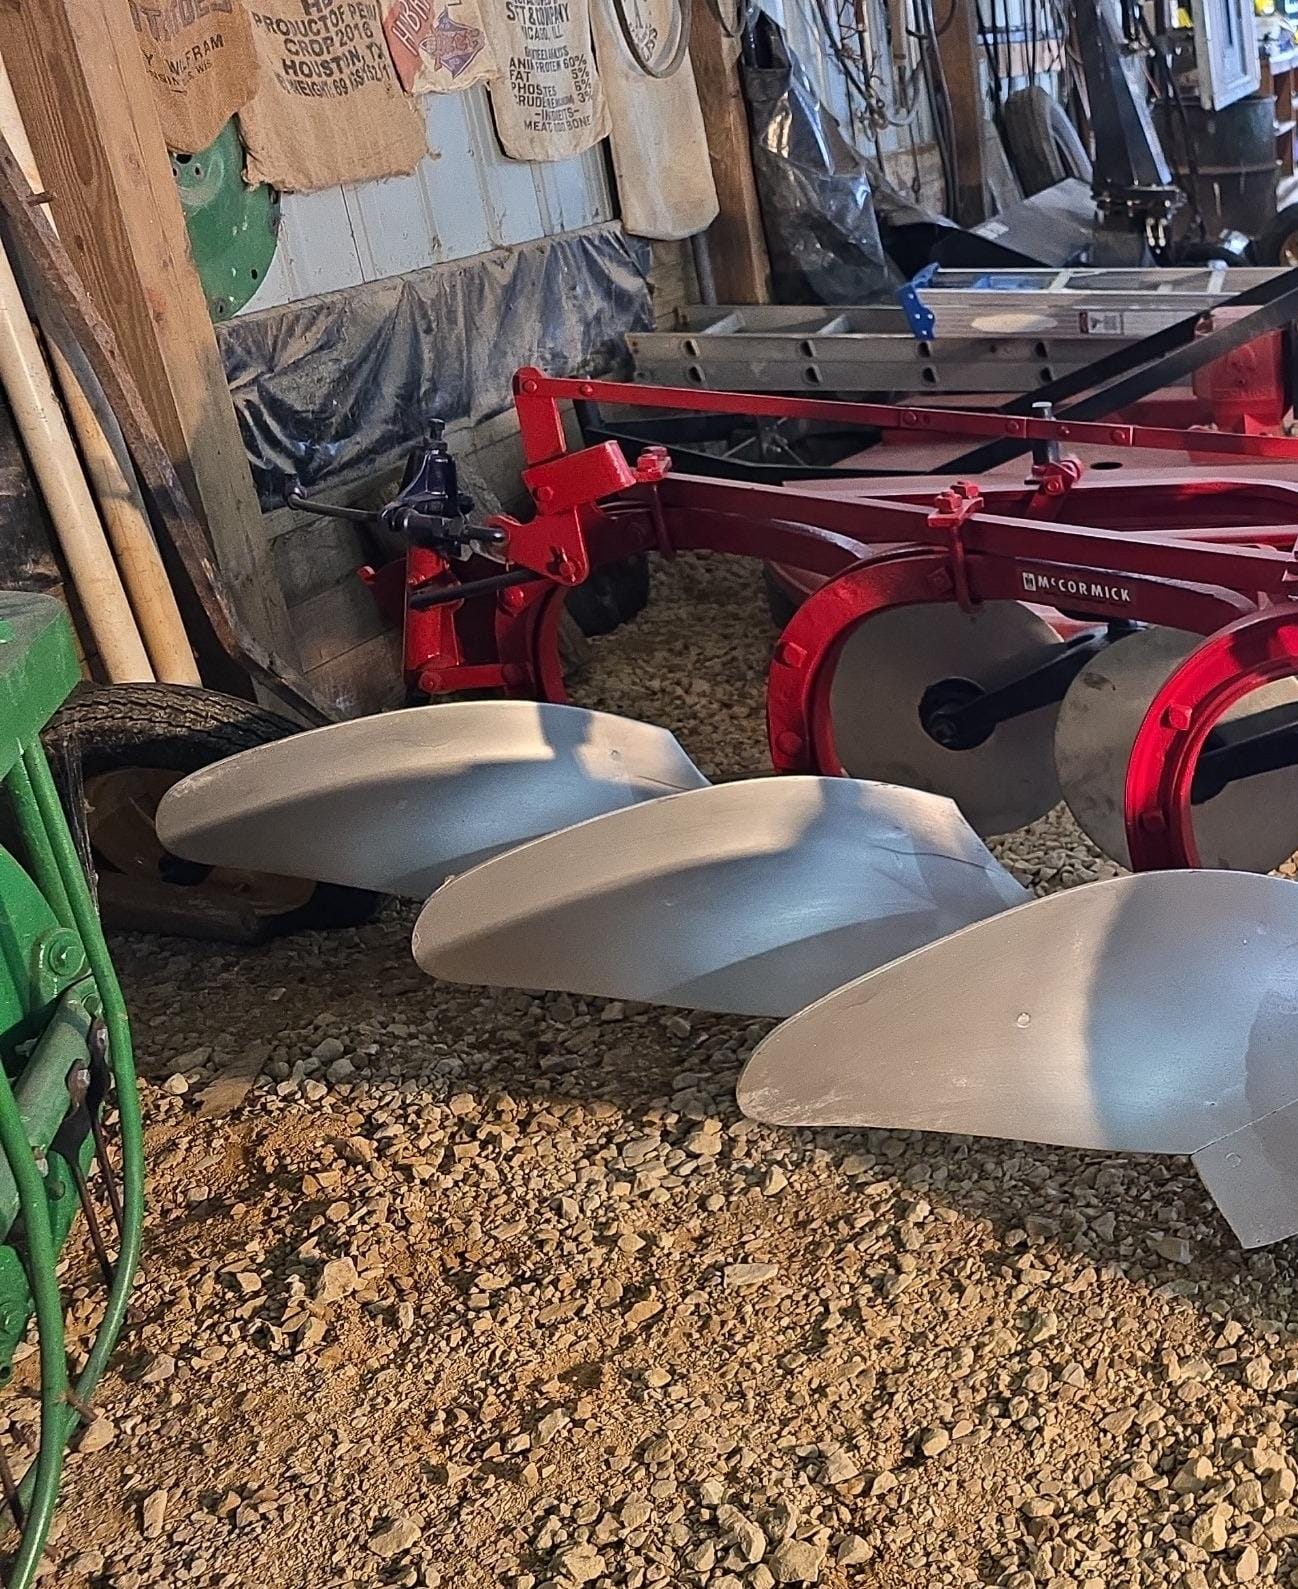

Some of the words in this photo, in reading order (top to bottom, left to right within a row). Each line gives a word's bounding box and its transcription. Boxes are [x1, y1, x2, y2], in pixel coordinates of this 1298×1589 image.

[251, 10, 331, 38] PRODUCT
[328, 5, 345, 28] OF
[284, 37, 335, 57] CROP
[336, 21, 374, 47] 2016
[563, 54, 588, 69] 60%
[509, 69, 531, 82] FAT
[571, 67, 590, 80] 5%
[333, 78, 349, 96] 69
[574, 78, 592, 92] 6%
[524, 119, 553, 132] MEAT
[566, 116, 591, 131] BONE
[1037, 575, 1132, 602] McCORMICK
